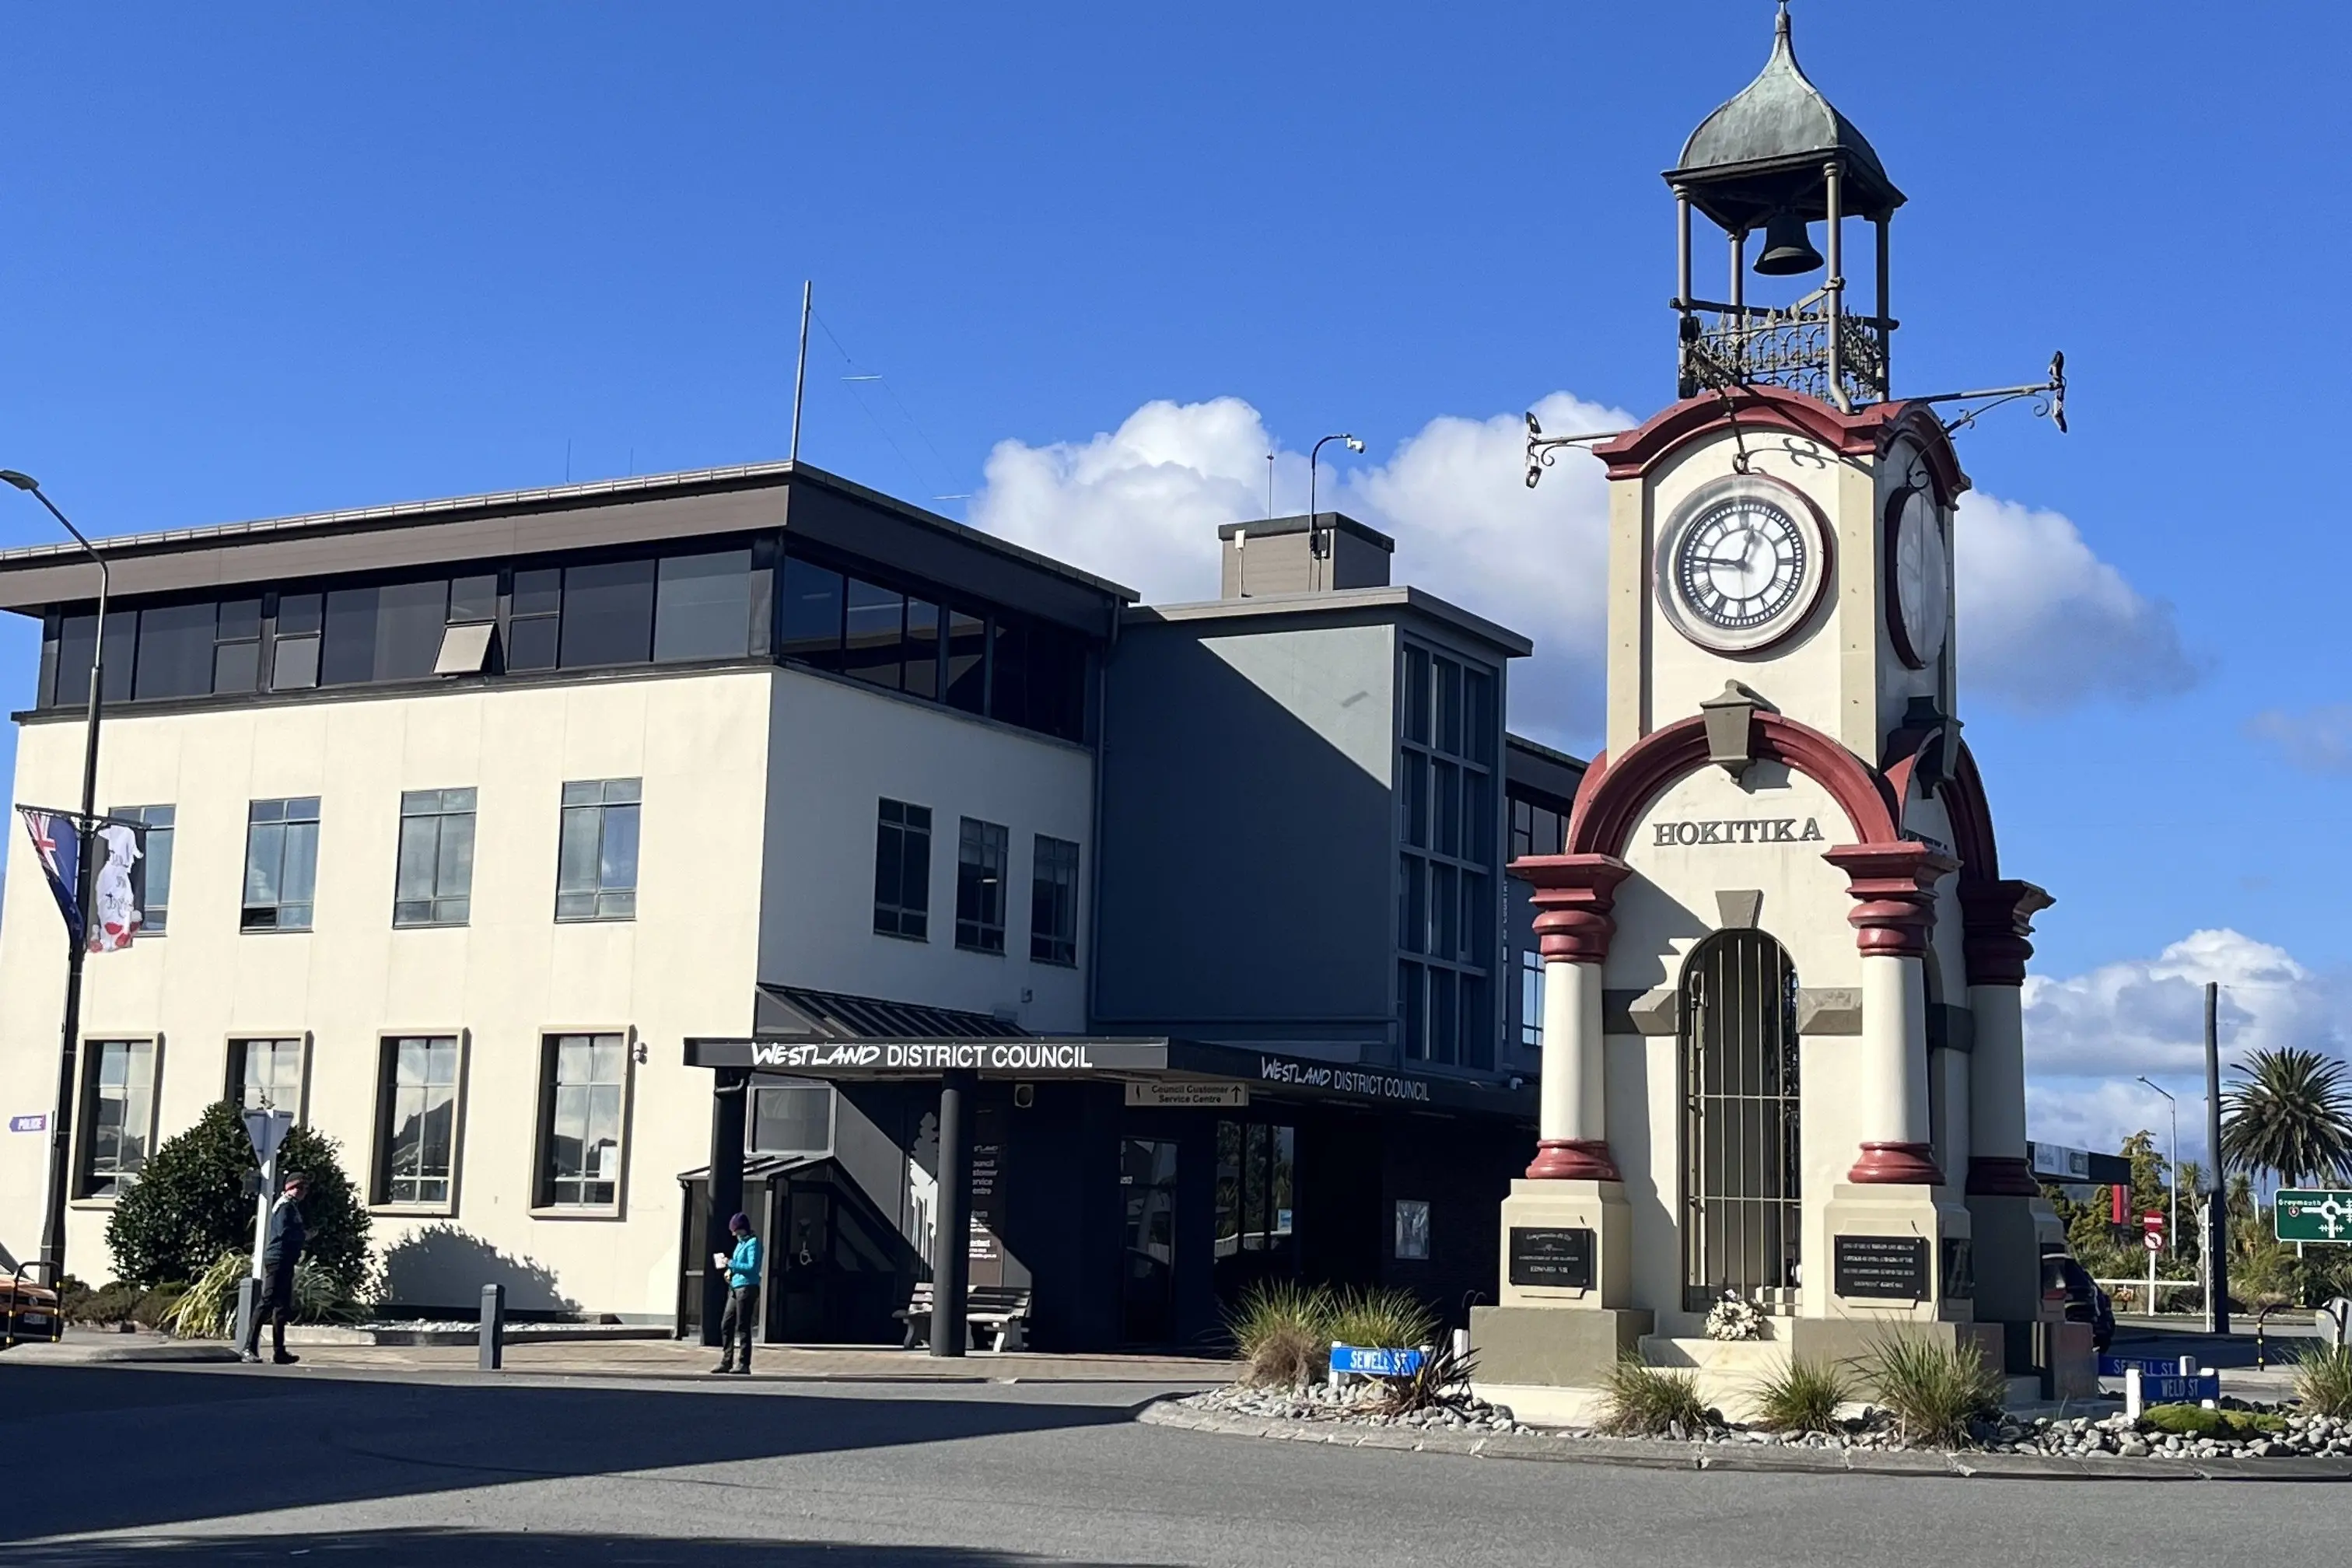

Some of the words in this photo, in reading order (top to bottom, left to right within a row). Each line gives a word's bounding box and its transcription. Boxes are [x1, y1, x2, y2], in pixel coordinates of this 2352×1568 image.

[1653, 817, 1825, 846] HOKITIKA
[751, 1041, 880, 1066] WESTLAND
[887, 1045, 987, 1067] DISTRICT
[992, 1045, 1093, 1068] COUNCIL
[1261, 1055, 1331, 1086] WESTLAND
[1334, 1070, 1383, 1095] DISTRICT
[1384, 1077, 1430, 1101] COUNCIL
[1151, 1084, 1184, 1094] Council
[1186, 1084, 1228, 1094] Customer
[1159, 1094, 1190, 1103] Service
[1192, 1094, 1221, 1103] Centre
[2278, 1199, 2321, 1207] Greymouth
[1350, 1350, 1389, 1370] SEWELL
[2112, 1359, 2156, 1376] SELL
[2161, 1362, 2175, 1376] ST
[2161, 1379, 2186, 1397] WELD
[2187, 1378, 2199, 1397] ST
